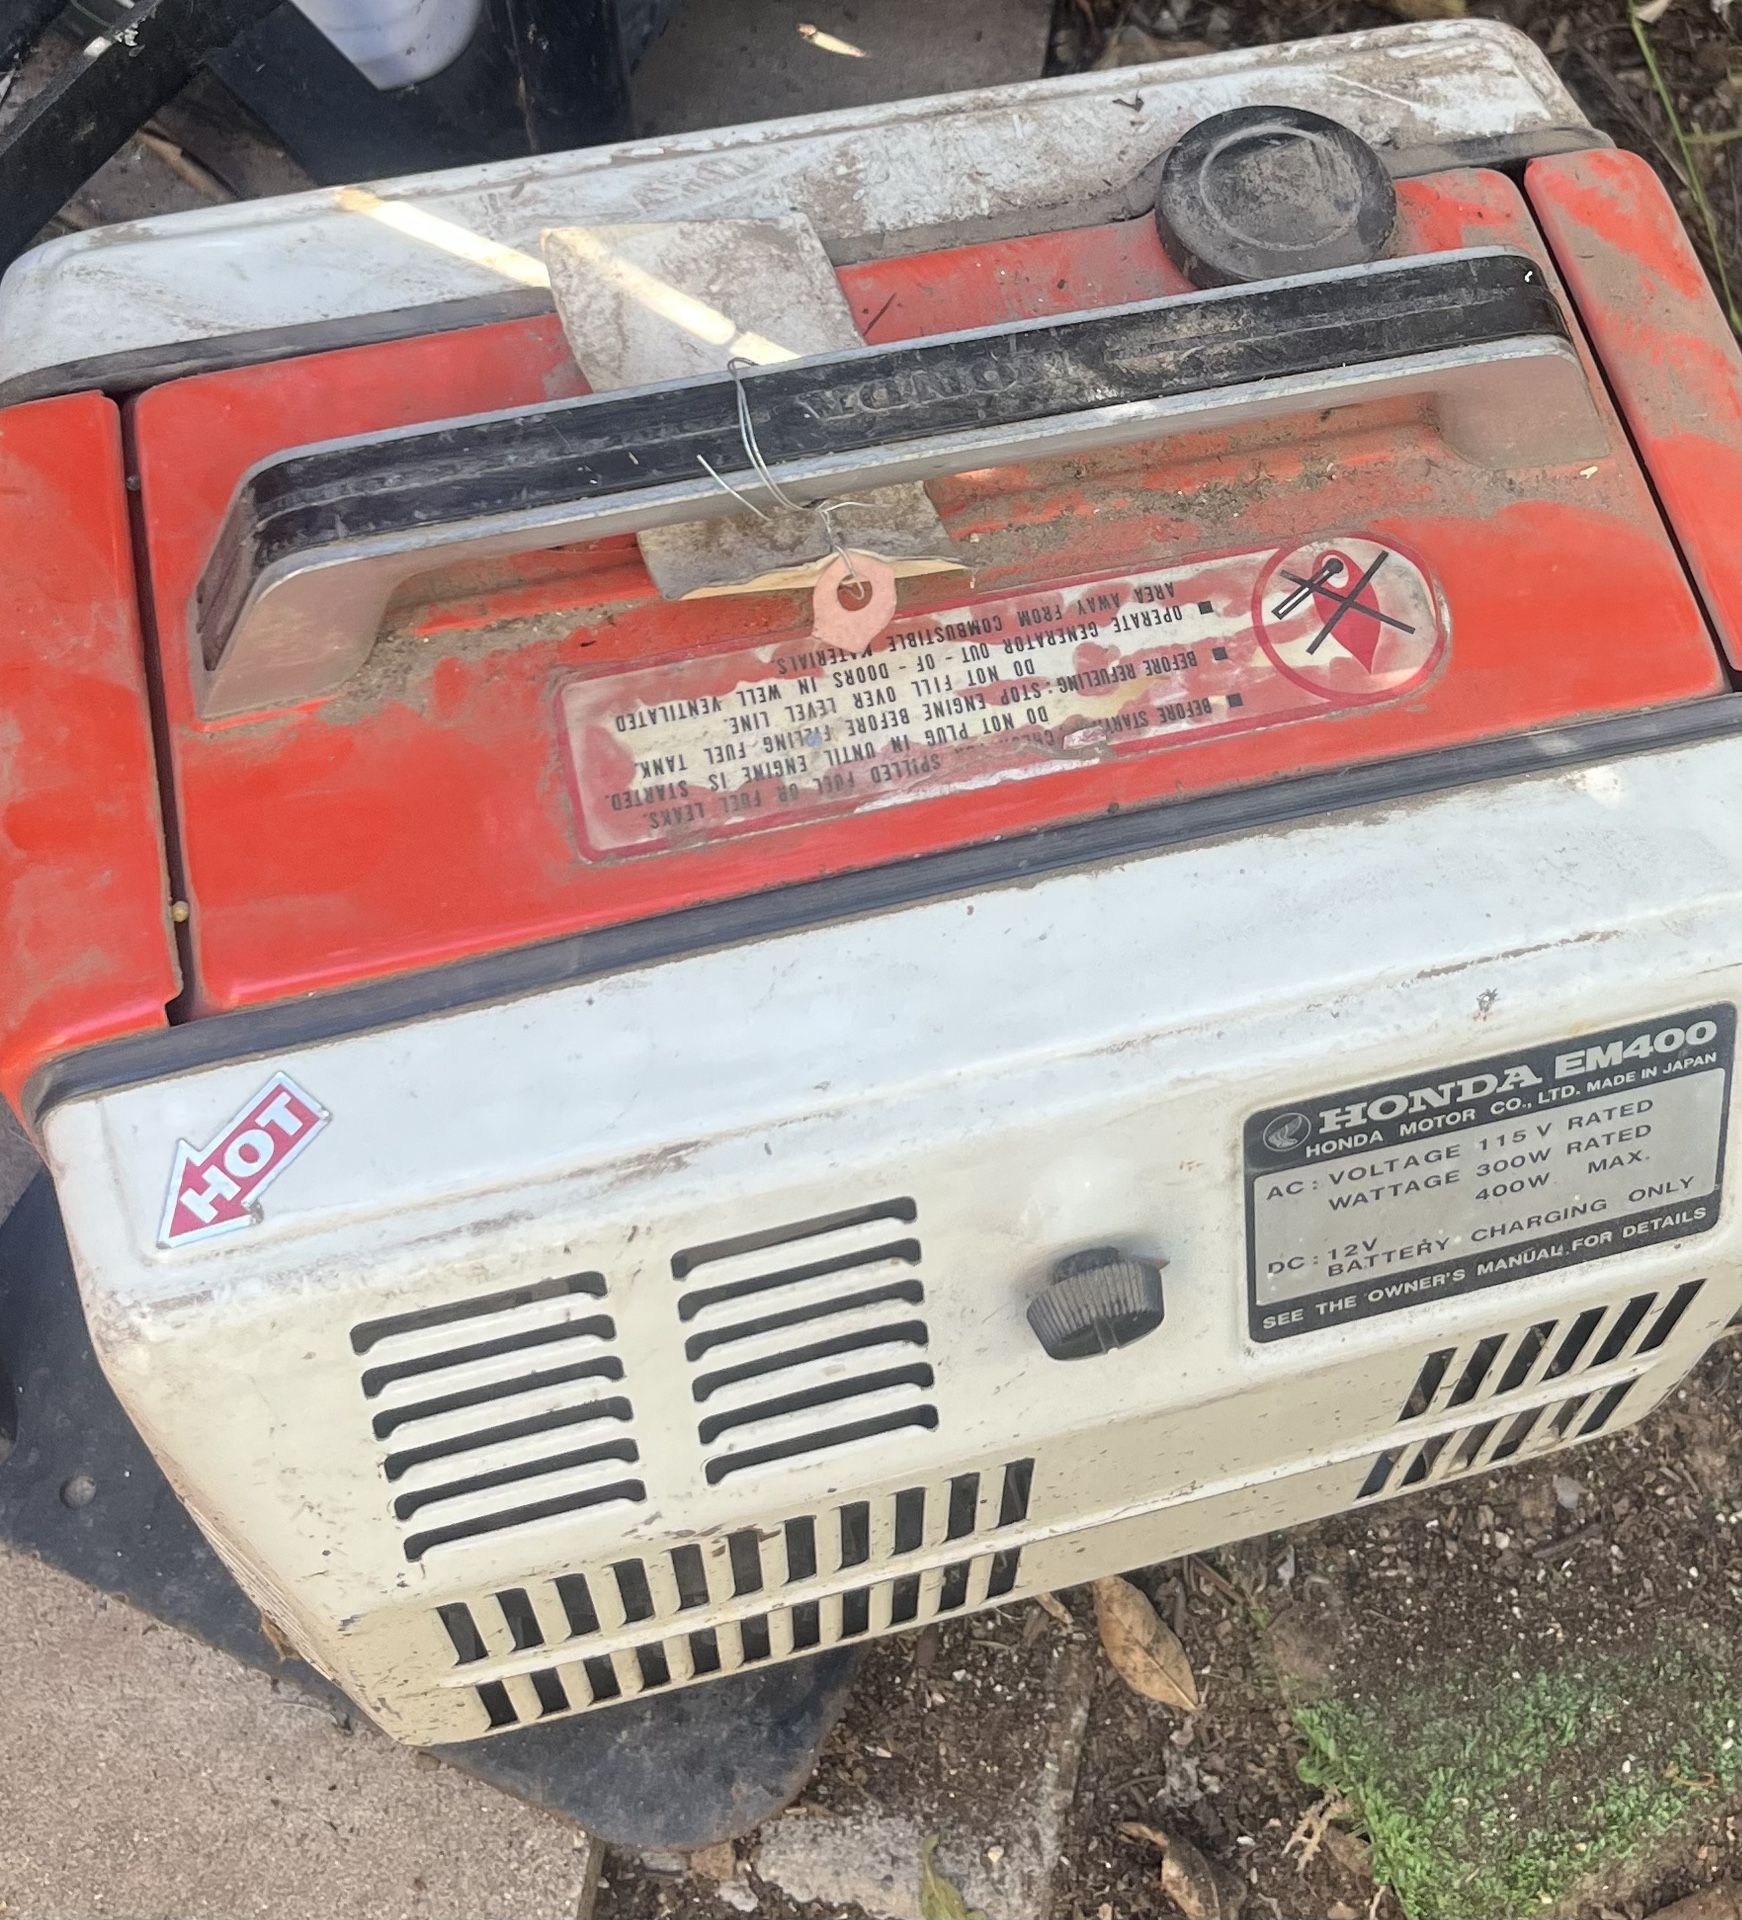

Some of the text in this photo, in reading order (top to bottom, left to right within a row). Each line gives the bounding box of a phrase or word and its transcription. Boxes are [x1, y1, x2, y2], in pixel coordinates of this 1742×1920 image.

[1073, 592, 1120, 614] AWAY
[1133, 582, 1175, 604] AREA
[1016, 604, 1062, 628] FROM
[1110, 604, 1182, 634] OPERATE
[886, 614, 1002, 652] COMBUSTIBLE
[1002, 621, 1098, 655] GENERATOR
[1142, 650, 1197, 677] BEFORE
[723, 658, 1035, 734] DO NOT FILL OVER LEVEL LINE.
[735, 684, 782, 707] WELL
[798, 676, 817, 696] IN
[1000, 682, 1042, 706] STOP
[614, 696, 722, 732] VENTILATED
[922, 692, 986, 721] ENGINE
[1156, 698, 1212, 724] BEFORE
[844, 708, 910, 737] BEFORE
[605, 705, 1048, 811] DO NOT PLUG IN UNTIL ENGINE IS STARTED.
[634, 754, 688, 780] TANK.
[704, 742, 746, 764] FUEL
[812, 772, 854, 795] FUEL
[870, 754, 941, 784] SPILLED
[718, 790, 761, 812] FUEL
[777, 784, 799, 802] OR
[642, 802, 704, 829] LEAKS.
[1319, 1020, 1718, 1134] HONDA EM400
[1306, 1052, 1717, 1158] HONDA MOTOR CO., LTD. MADE IN JAPAN
[1328, 1144, 1461, 1185] VOLTAGE
[1567, 1099, 1654, 1130] RATED
[179, 1091, 304, 1224] HOT
[1328, 1124, 1652, 1211] WATTAGE 300W RATED
[1475, 1150, 1650, 1201] 400W MAX.
[1328, 1175, 1695, 1277] BATTERY CHARGING ONLY
[1328, 1238, 1377, 1260] 12V
[1263, 1306, 1305, 1331] SEE
[1316, 1294, 1357, 1316] THE
[1367, 1267, 1466, 1303] OWNER'S
[1571, 1231, 1613, 1252] FOR
[1622, 1206, 1707, 1239] DETAILS
